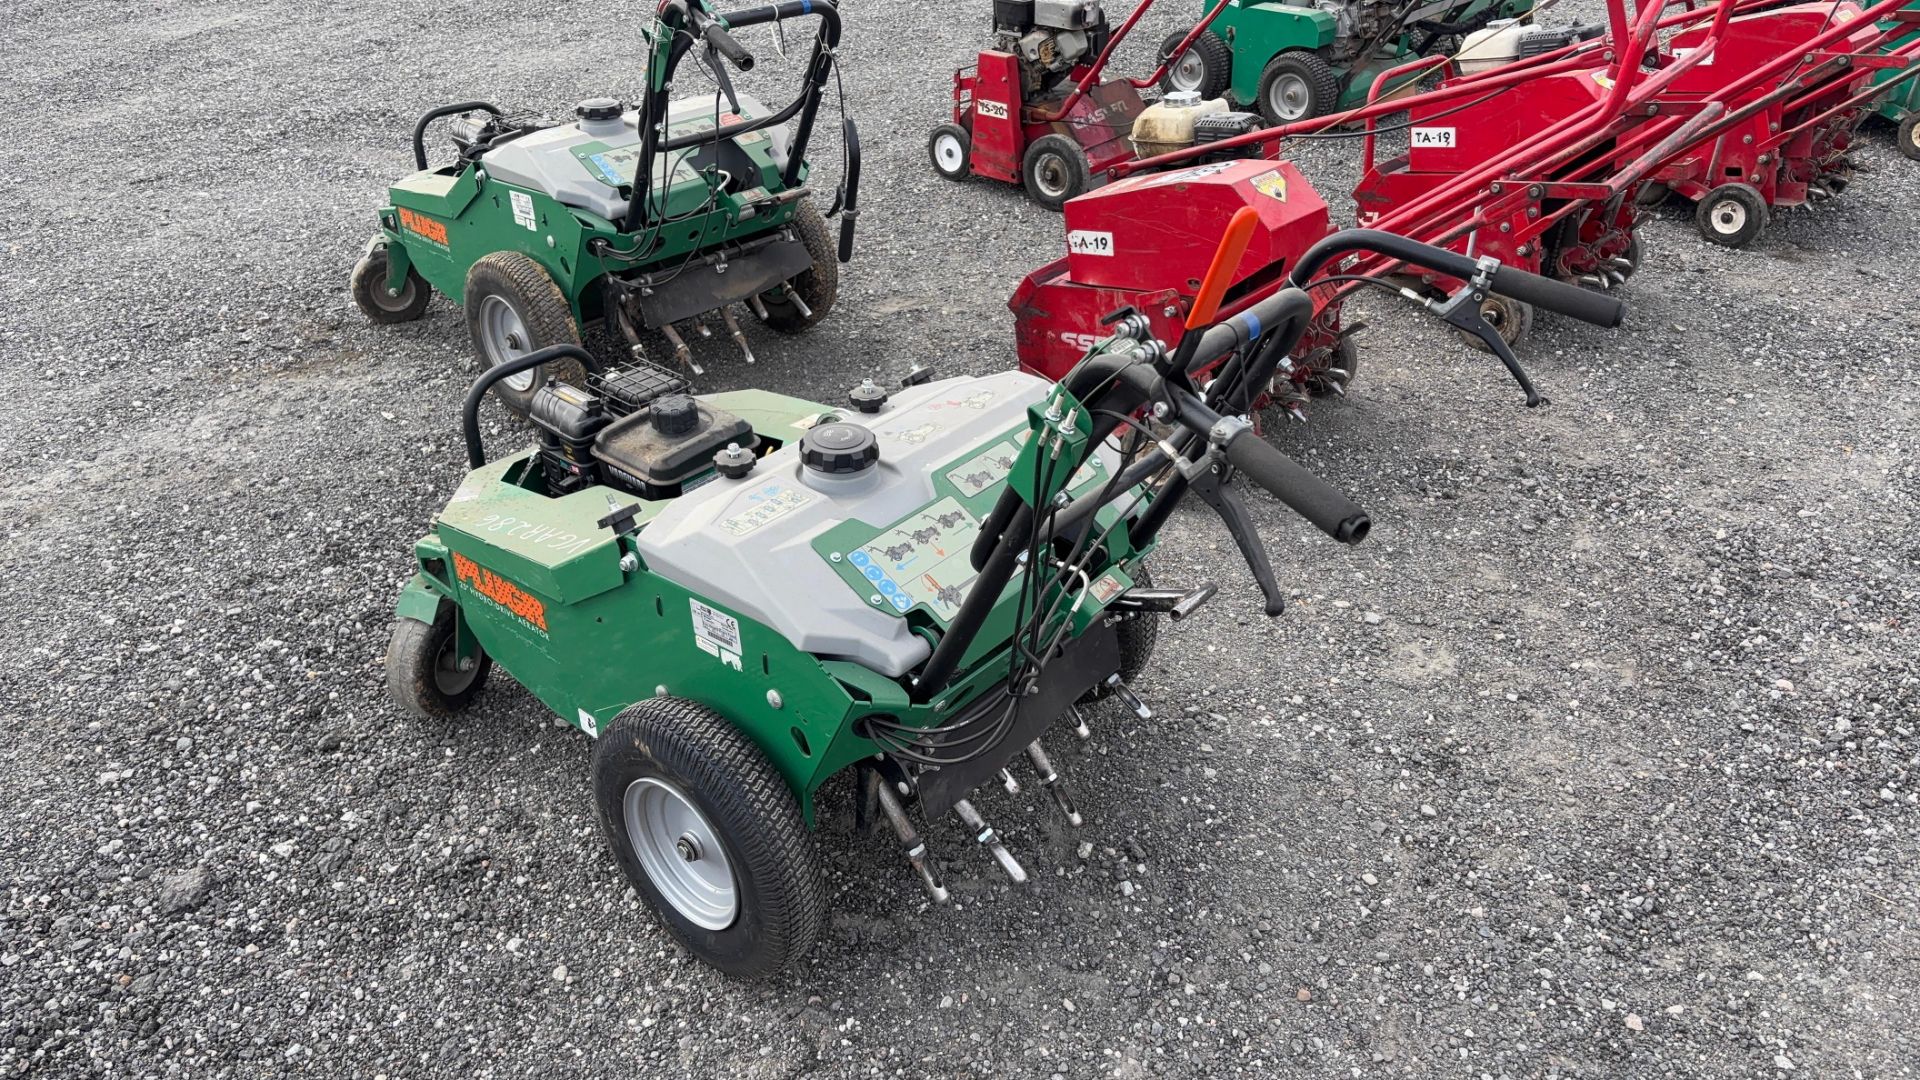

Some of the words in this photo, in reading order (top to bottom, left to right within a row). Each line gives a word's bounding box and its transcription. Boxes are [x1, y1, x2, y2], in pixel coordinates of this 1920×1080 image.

[979, 101, 1005, 116] TS-20
[1415, 131, 1451, 144] TA-19
[1071, 235, 1109, 250] A-19
[475, 513, 591, 554] VGAR286
[517, 616, 550, 642] AERATOR
